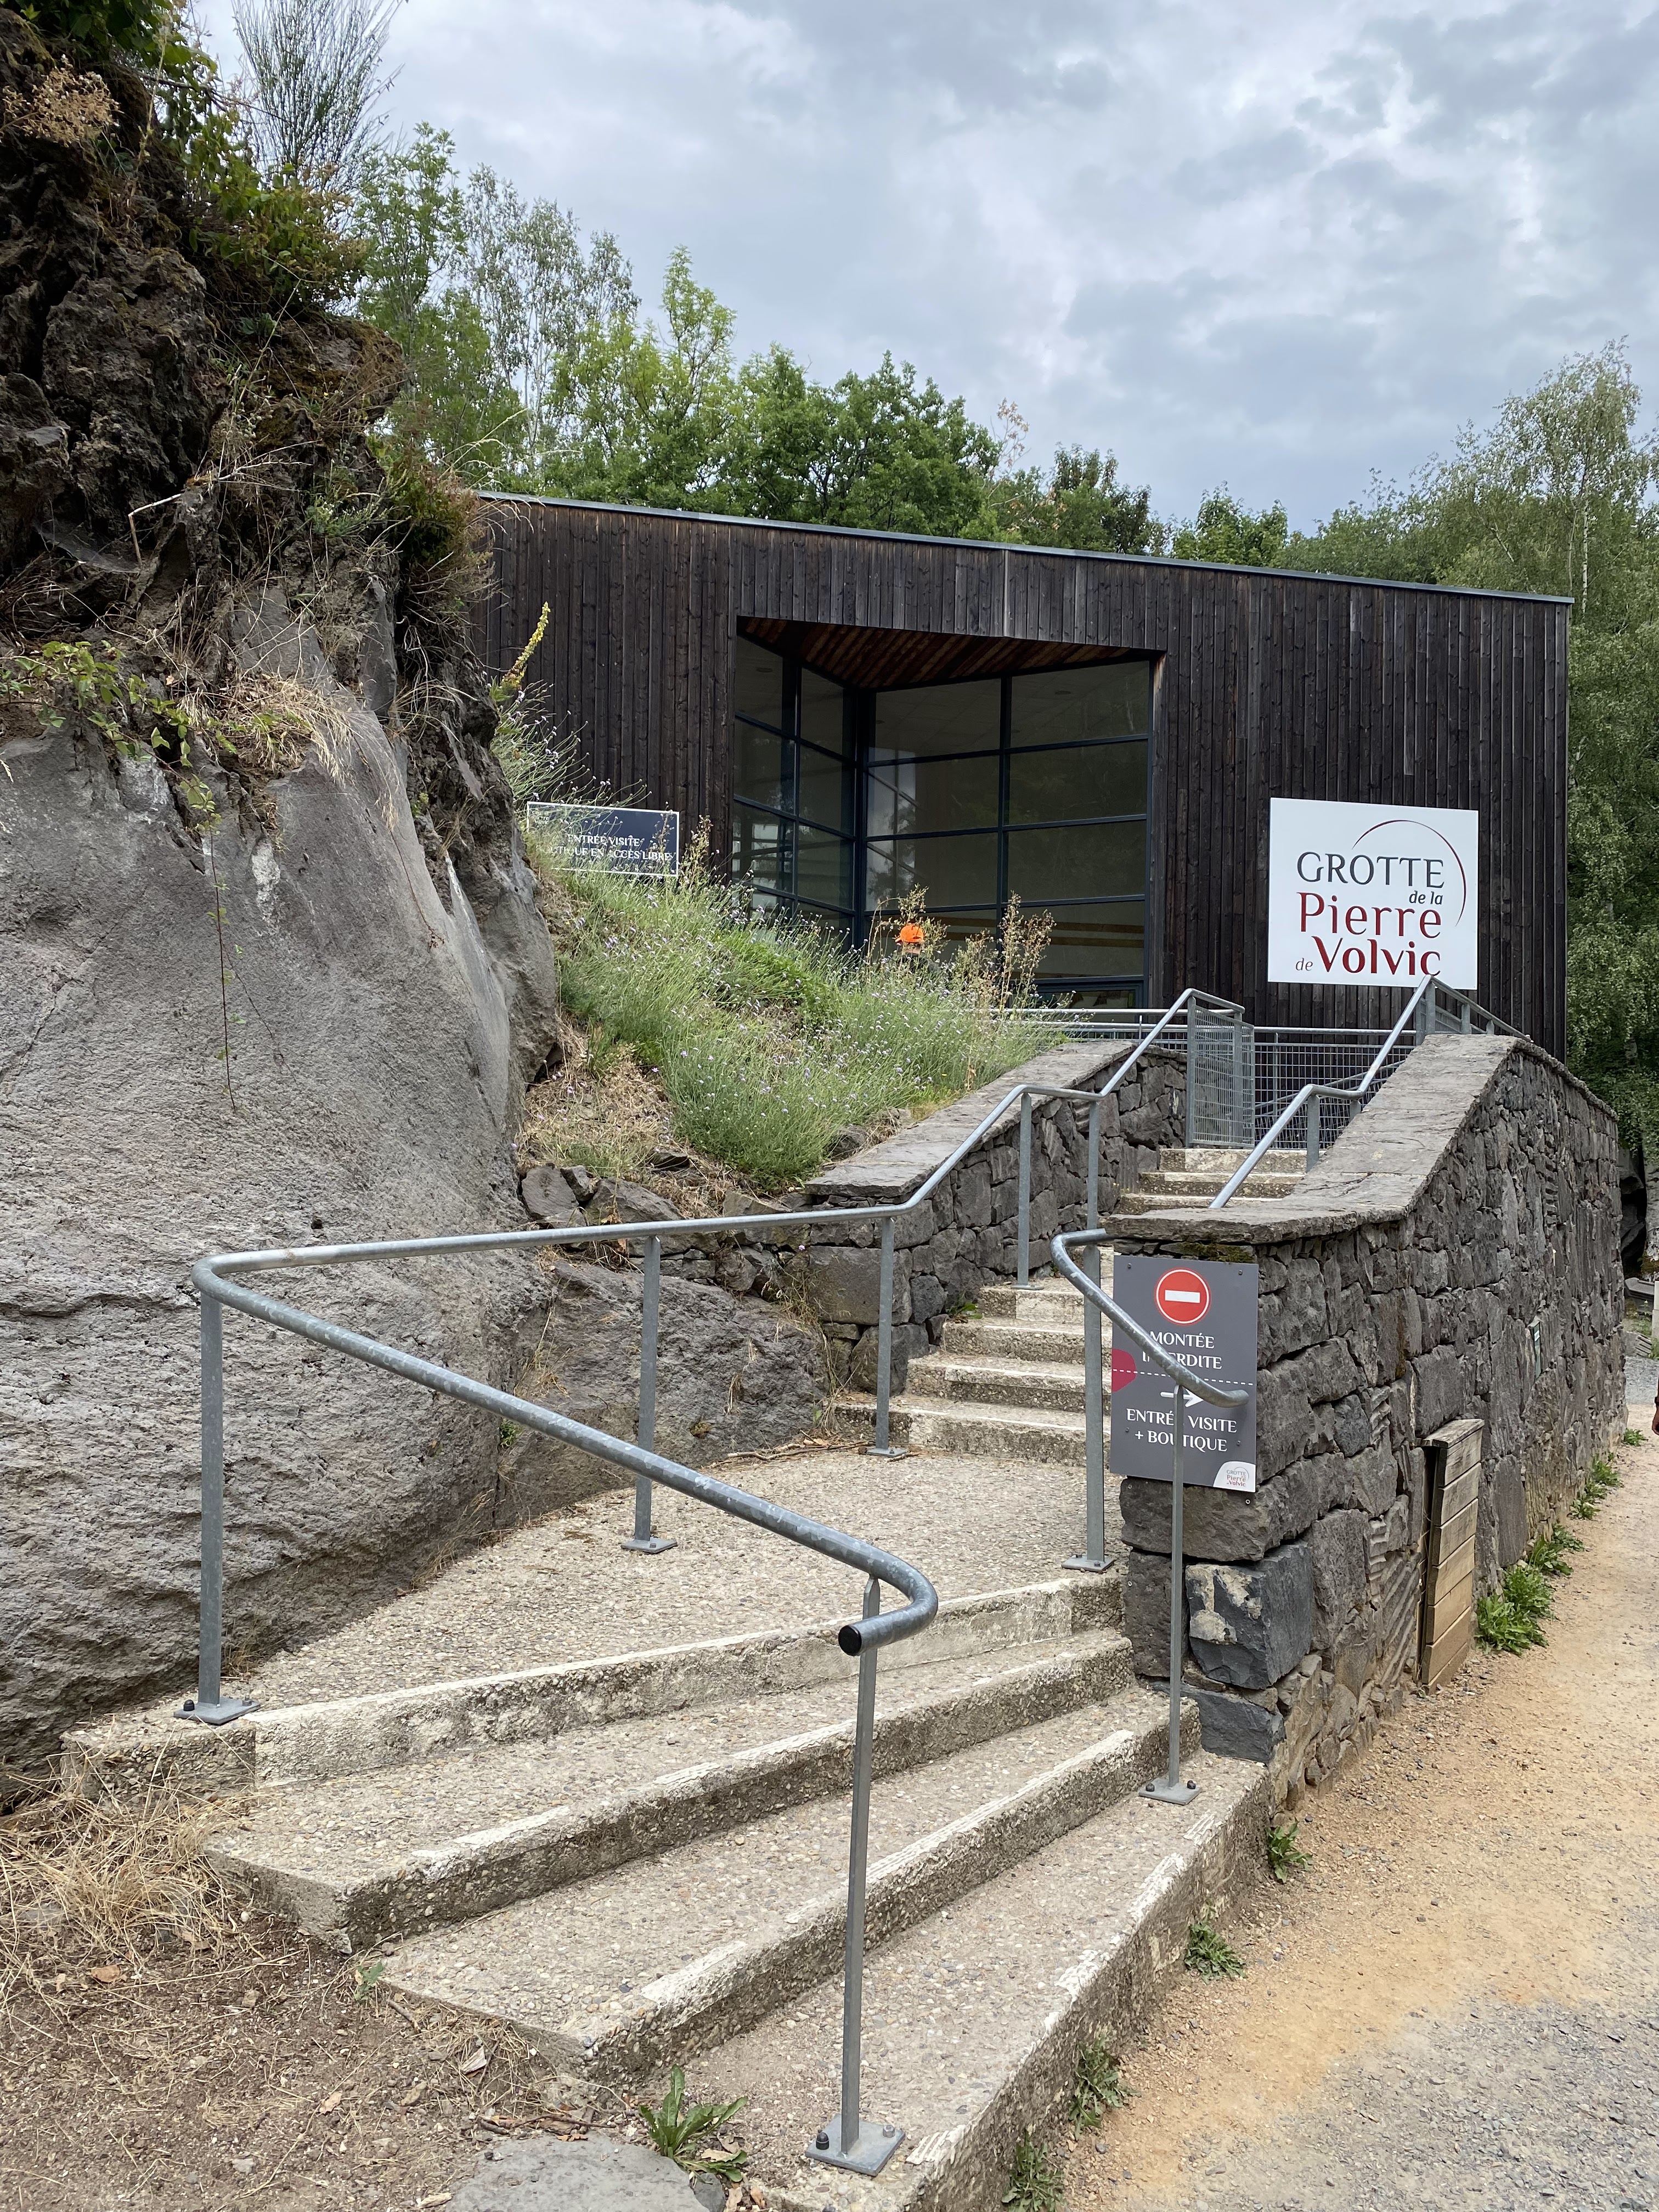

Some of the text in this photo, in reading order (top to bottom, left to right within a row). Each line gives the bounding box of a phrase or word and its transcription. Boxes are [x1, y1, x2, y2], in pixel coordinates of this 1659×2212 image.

[608, 836, 640, 847] VISITE
[1296, 851, 1445, 889] GROTTE
[1408, 890, 1444, 905] de la
[1296, 891, 1442, 939] Pierre
[1295, 935, 1441, 977] de Volvic
[1150, 1331, 1215, 1349] MONTÉE
[1126, 1408, 1238, 1433] ENTRÉ VISITE
[1135, 1431, 1144, 1440] +
[1227, 1474, 1246, 1482] Pierre
